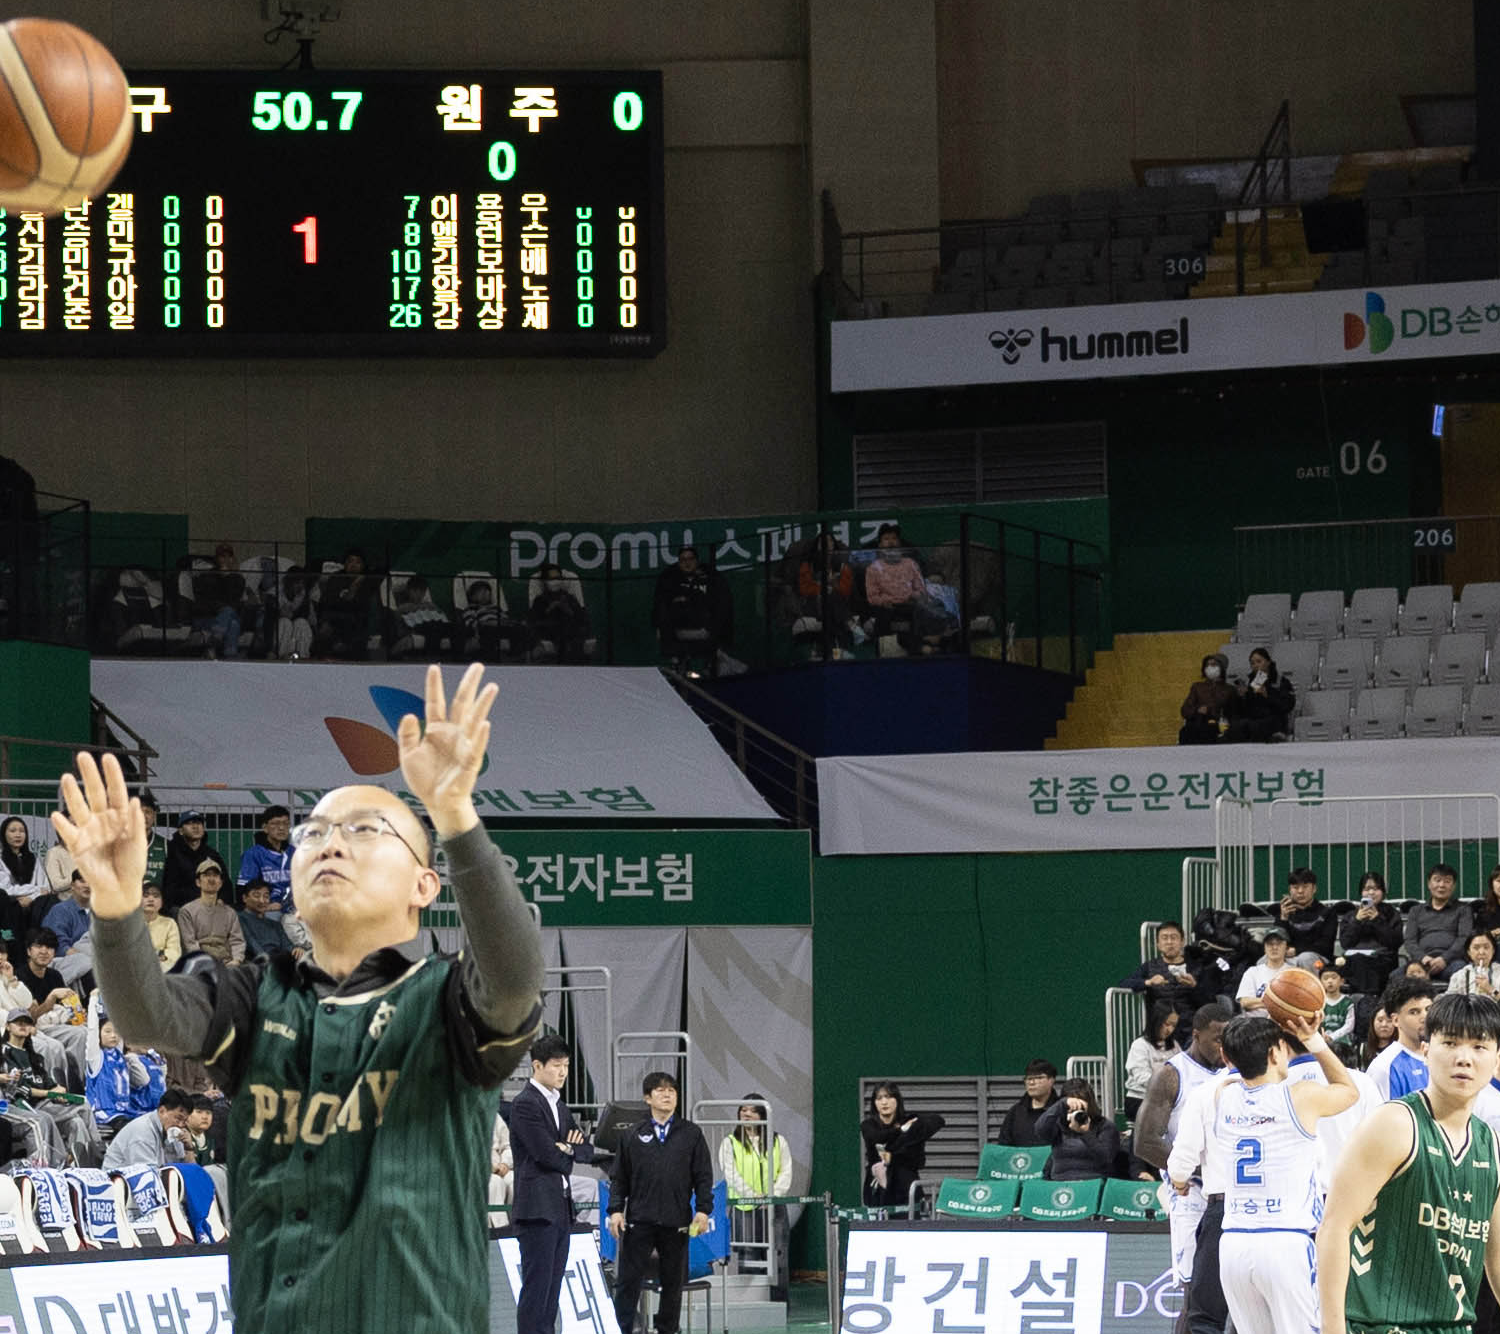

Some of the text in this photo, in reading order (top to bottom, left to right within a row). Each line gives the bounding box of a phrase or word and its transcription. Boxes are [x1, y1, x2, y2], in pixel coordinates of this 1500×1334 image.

[251, 90, 364, 132] 50.7
[612, 90, 645, 132] 0
[487, 140, 518, 182] 0
[403, 195, 421, 220] 7
[291, 216, 318, 264] 1
[403, 222, 421, 246] 8
[390, 249, 421, 274] 10
[1164, 257, 1204, 277] 306
[391, 275, 421, 301] 17
[389, 302, 422, 328] 26
[1039, 318, 1190, 366] hummel
[1295, 440, 1389, 480] GATE 06
[1412, 528, 1455, 549] 206
[1027, 767, 1326, 816] 참좋은운전자보험
[1232, 1135, 1265, 1188] 2
